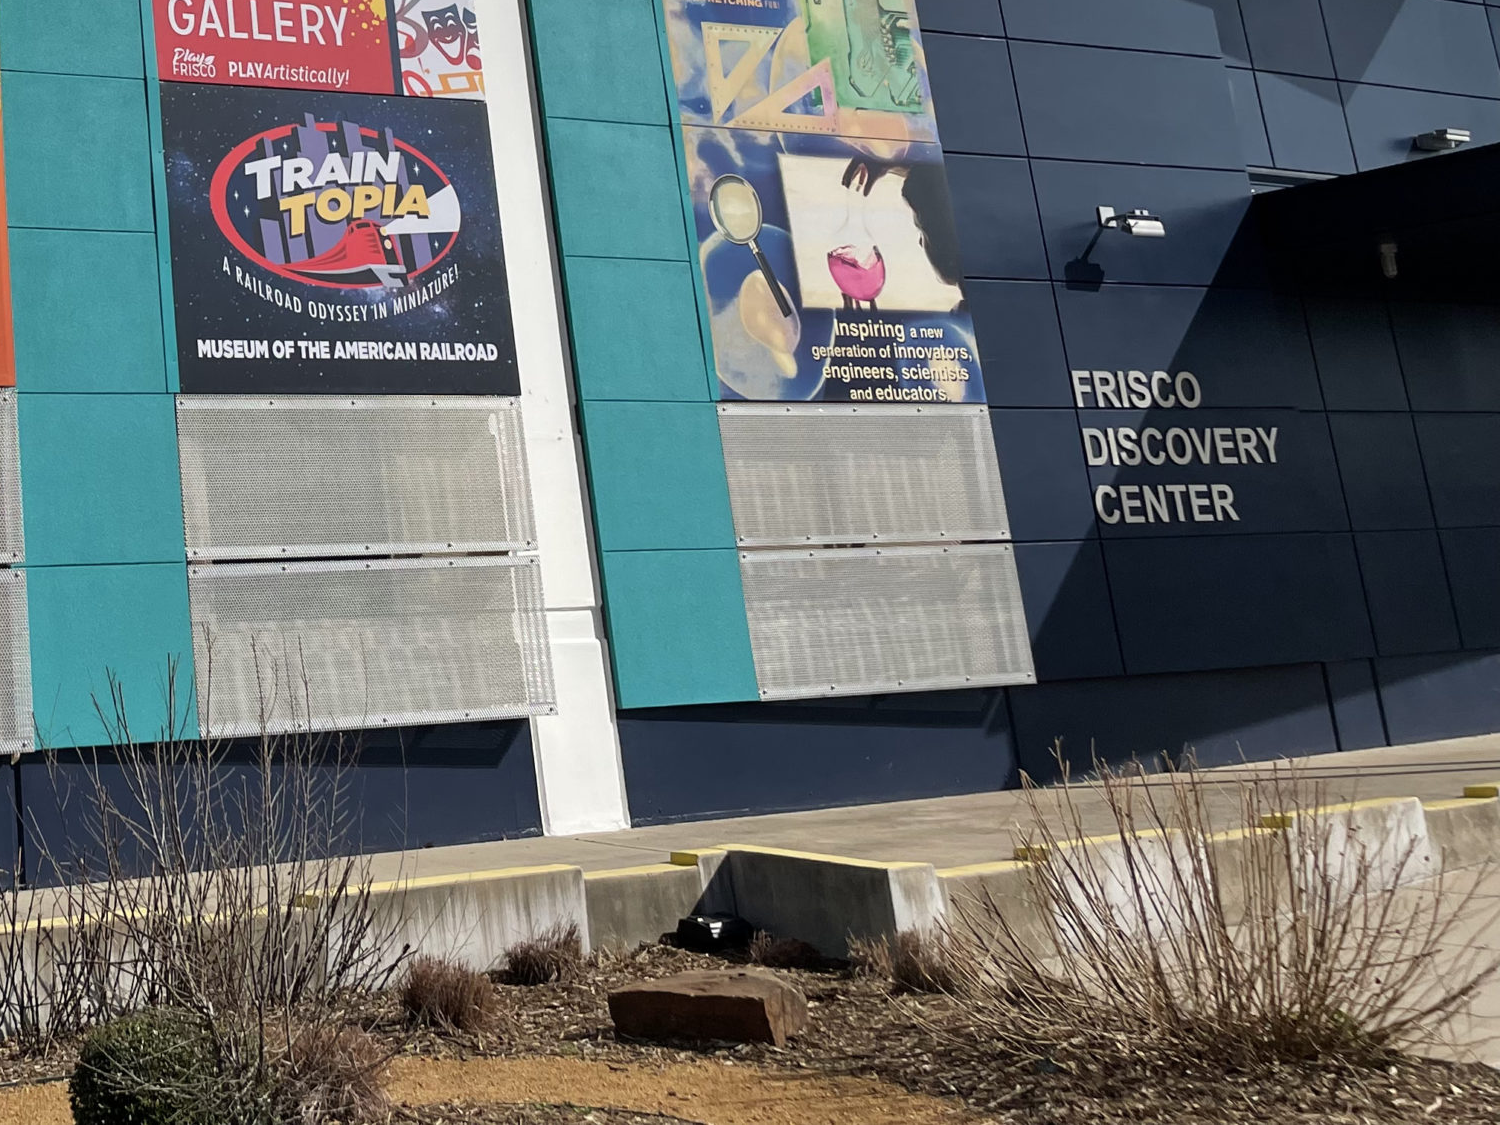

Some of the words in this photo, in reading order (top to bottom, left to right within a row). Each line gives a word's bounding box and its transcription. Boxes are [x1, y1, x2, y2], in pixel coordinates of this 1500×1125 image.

[173, 47, 206, 66] Play
[173, 62, 217, 78] FRISCO
[244, 151, 401, 201] TRAIN
[279, 184, 431, 237] TOPIA
[222, 256, 231, 275] A
[235, 265, 302, 313] RAILROAD
[308, 300, 368, 322] ODYSSEY
[373, 302, 388, 319] IN
[393, 263, 459, 316] MINIATURE!
[834, 318, 906, 342] Inspiring
[910, 327, 918, 339] a
[920, 327, 944, 339] new
[197, 338, 269, 360] MUSEUM
[272, 339, 295, 359] OF
[298, 340, 330, 360] THE
[334, 341, 418, 361] AMERICAN
[420, 342, 498, 361] RAILROAD
[811, 343, 877, 361] generation
[879, 344, 892, 359] of
[892, 342, 973, 362] innovators,
[822, 362, 899, 383] engineers,
[901, 363, 970, 381] scientists
[850, 387, 873, 401] and
[1071, 370, 1201, 408] FRISCO
[1081, 427, 1278, 466] DISCOVERY
[1094, 484, 1241, 525] CENTER
